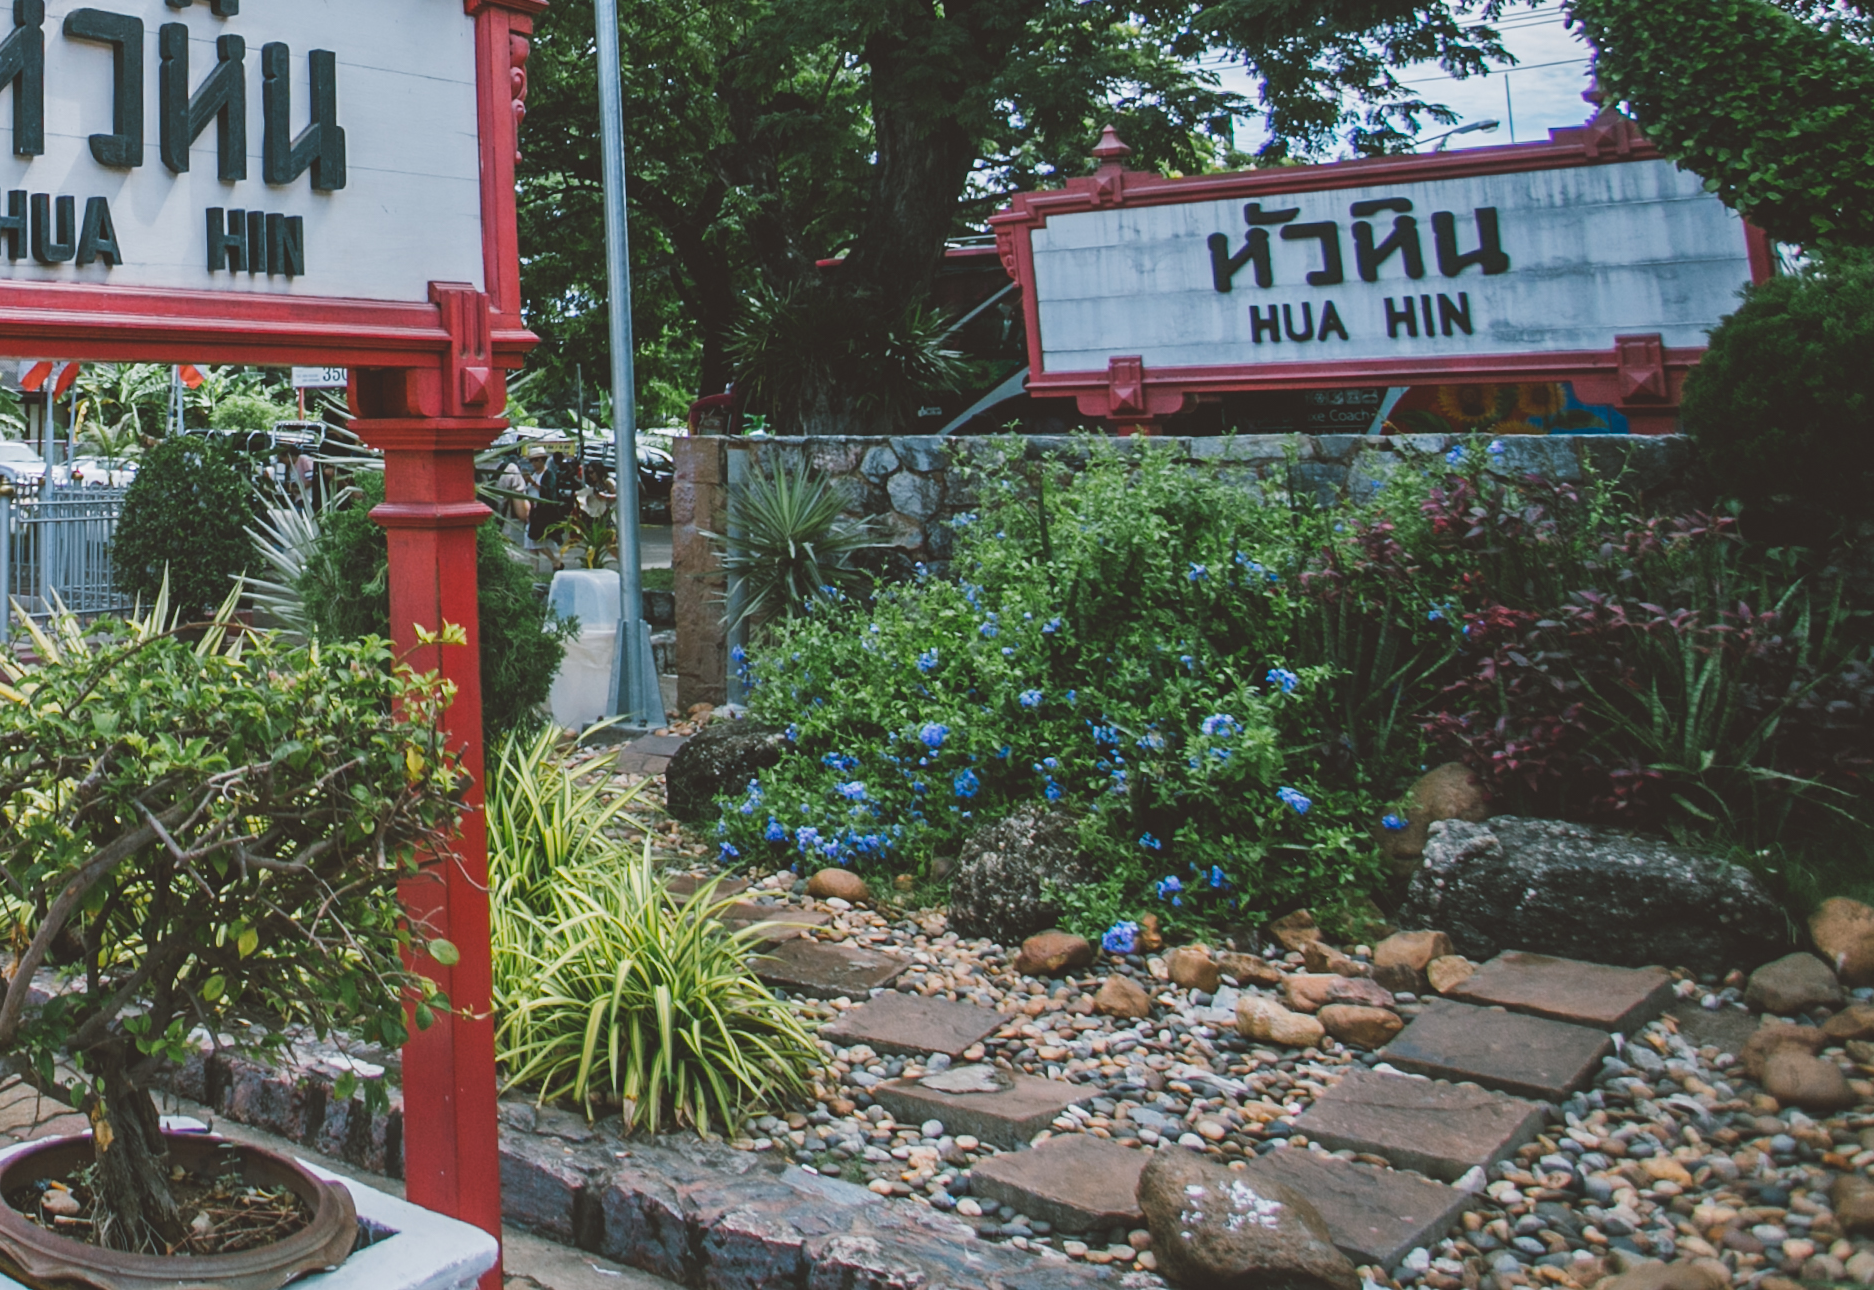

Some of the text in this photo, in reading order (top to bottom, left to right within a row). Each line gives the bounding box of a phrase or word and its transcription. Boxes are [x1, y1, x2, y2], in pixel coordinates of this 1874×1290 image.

[206, 206, 305, 277] HIN
[1207, 196, 1511, 293] หัวหิน
[1249, 292, 1474, 344] HUA HIN
[1328, 408, 1370, 422] Coach
